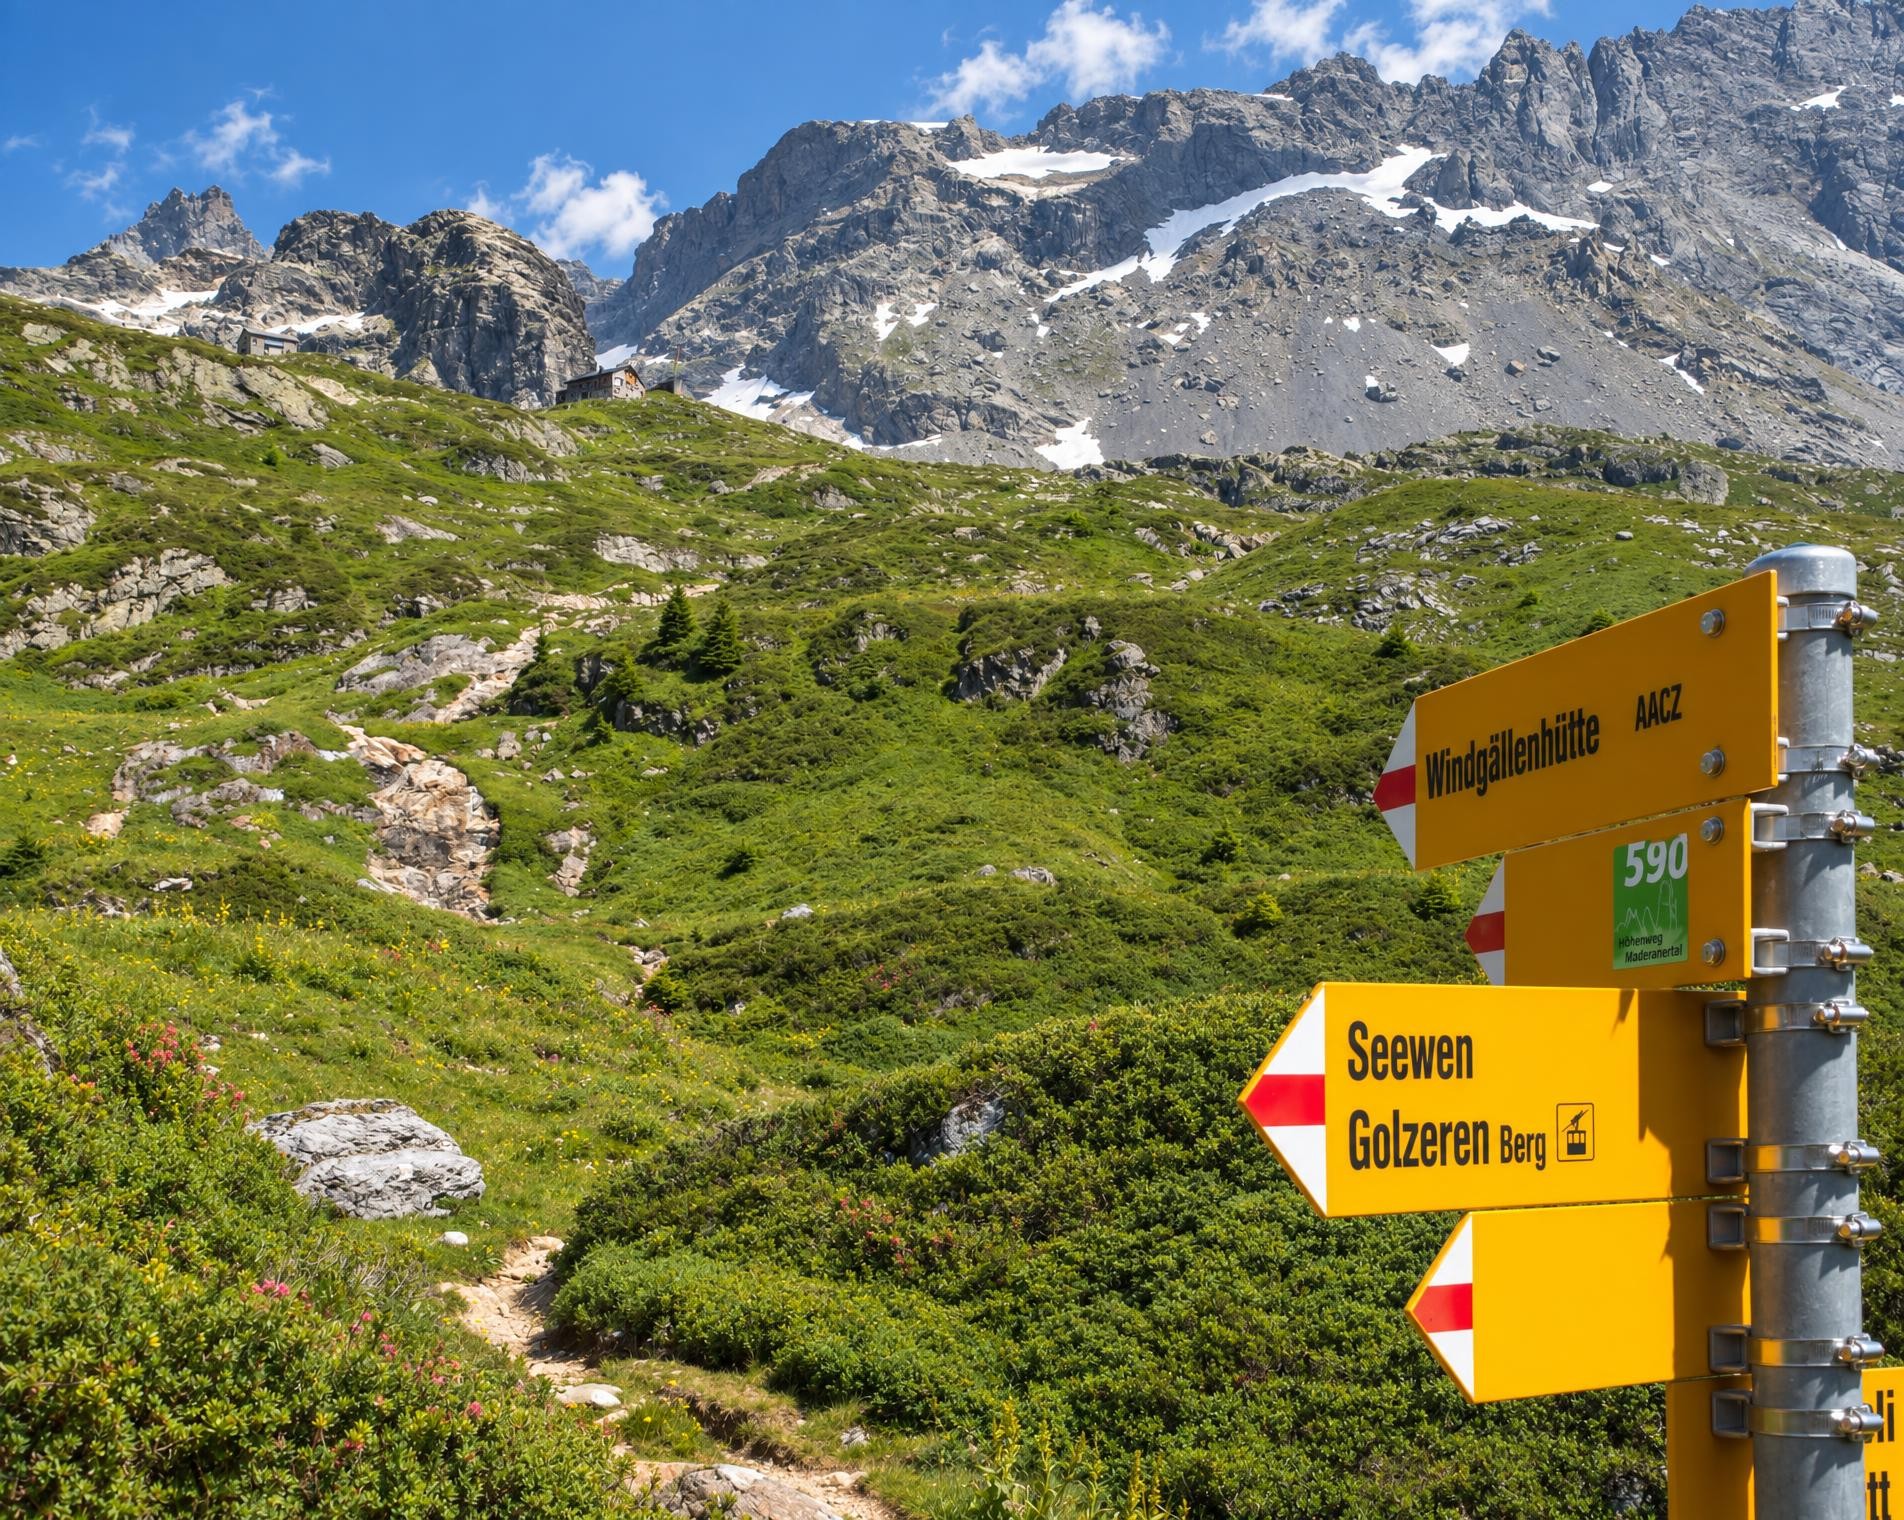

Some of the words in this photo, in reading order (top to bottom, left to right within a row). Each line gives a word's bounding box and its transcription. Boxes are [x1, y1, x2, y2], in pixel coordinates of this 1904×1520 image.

[1426, 708, 1599, 799] Windgällenhütte
[1635, 684, 1682, 732] AACZ
[1624, 833, 1688, 887] 590
[1618, 934, 1663, 949] Höhenweg
[1625, 944, 1682, 963] Maderanertal
[1348, 1020, 1473, 1081] Seewen
[1349, 1109, 1489, 1170] Golzeren
[1500, 1125, 1546, 1170] Berg
